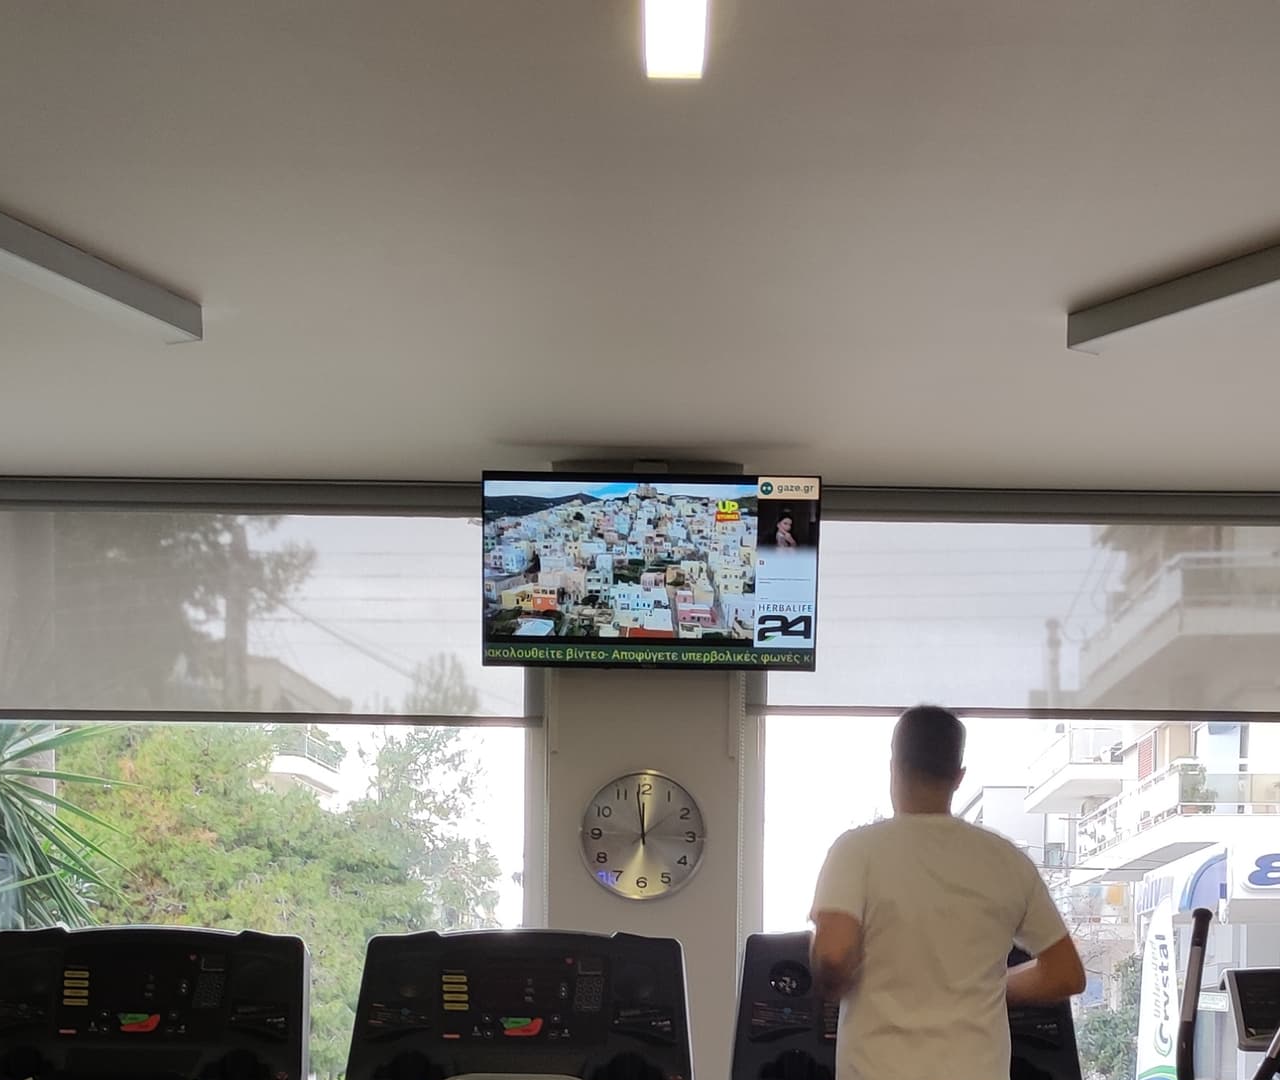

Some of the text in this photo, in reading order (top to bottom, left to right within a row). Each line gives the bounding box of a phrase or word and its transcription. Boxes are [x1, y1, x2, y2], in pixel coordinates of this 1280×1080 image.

[777, 484, 815, 494] gaze.gr
[758, 603, 813, 612] HERBALIFE
[757, 614, 812, 641] 24
[485, 647, 563, 659] ακολουθείτε
[612, 649, 678, 662] Αποφύγετε
[682, 651, 757, 664] υπερβολικές
[761, 651, 803, 664] φωνές
[597, 805, 612, 818] 10
[680, 807, 690, 819] 2
[590, 828, 602, 839] 9
[685, 831, 696, 843] 3
[596, 851, 608, 863] 8
[677, 855, 688, 866] 4
[612, 870, 624, 881] 7
[660, 872, 672, 884] 5
[636, 876, 648, 889] 6
